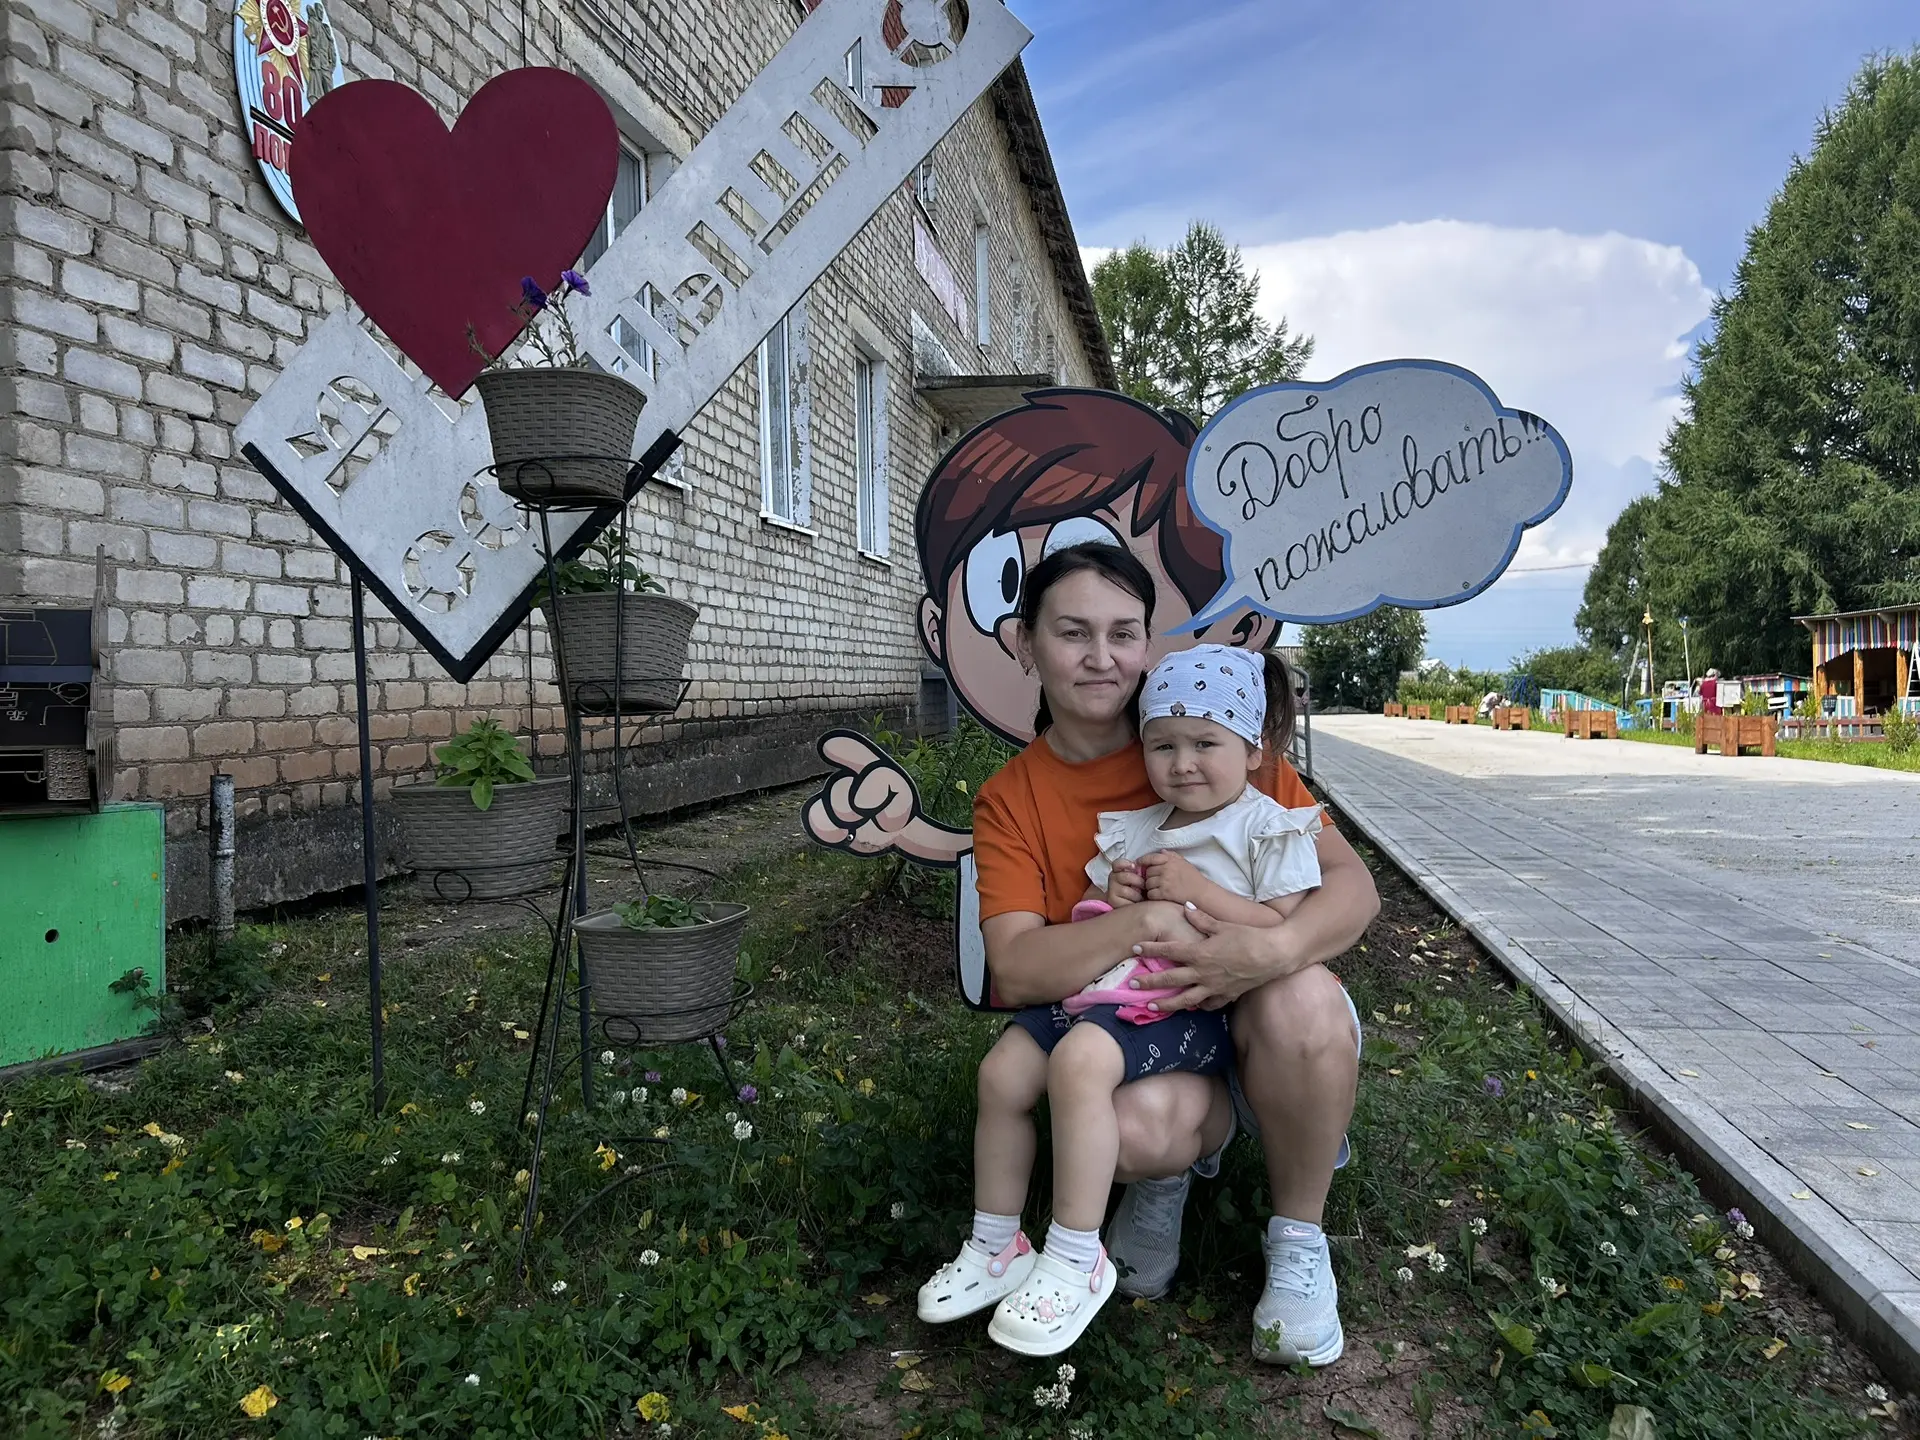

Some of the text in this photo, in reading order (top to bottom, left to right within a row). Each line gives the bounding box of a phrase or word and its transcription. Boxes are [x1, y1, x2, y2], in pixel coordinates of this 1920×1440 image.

[262, 60, 303, 132] 80
[401, 0, 969, 614] СОНЫШКО
[286, 375, 403, 497] Я
[1217, 394, 1382, 520] Добро
[1254, 408, 1549, 601] пожаловать!!!
